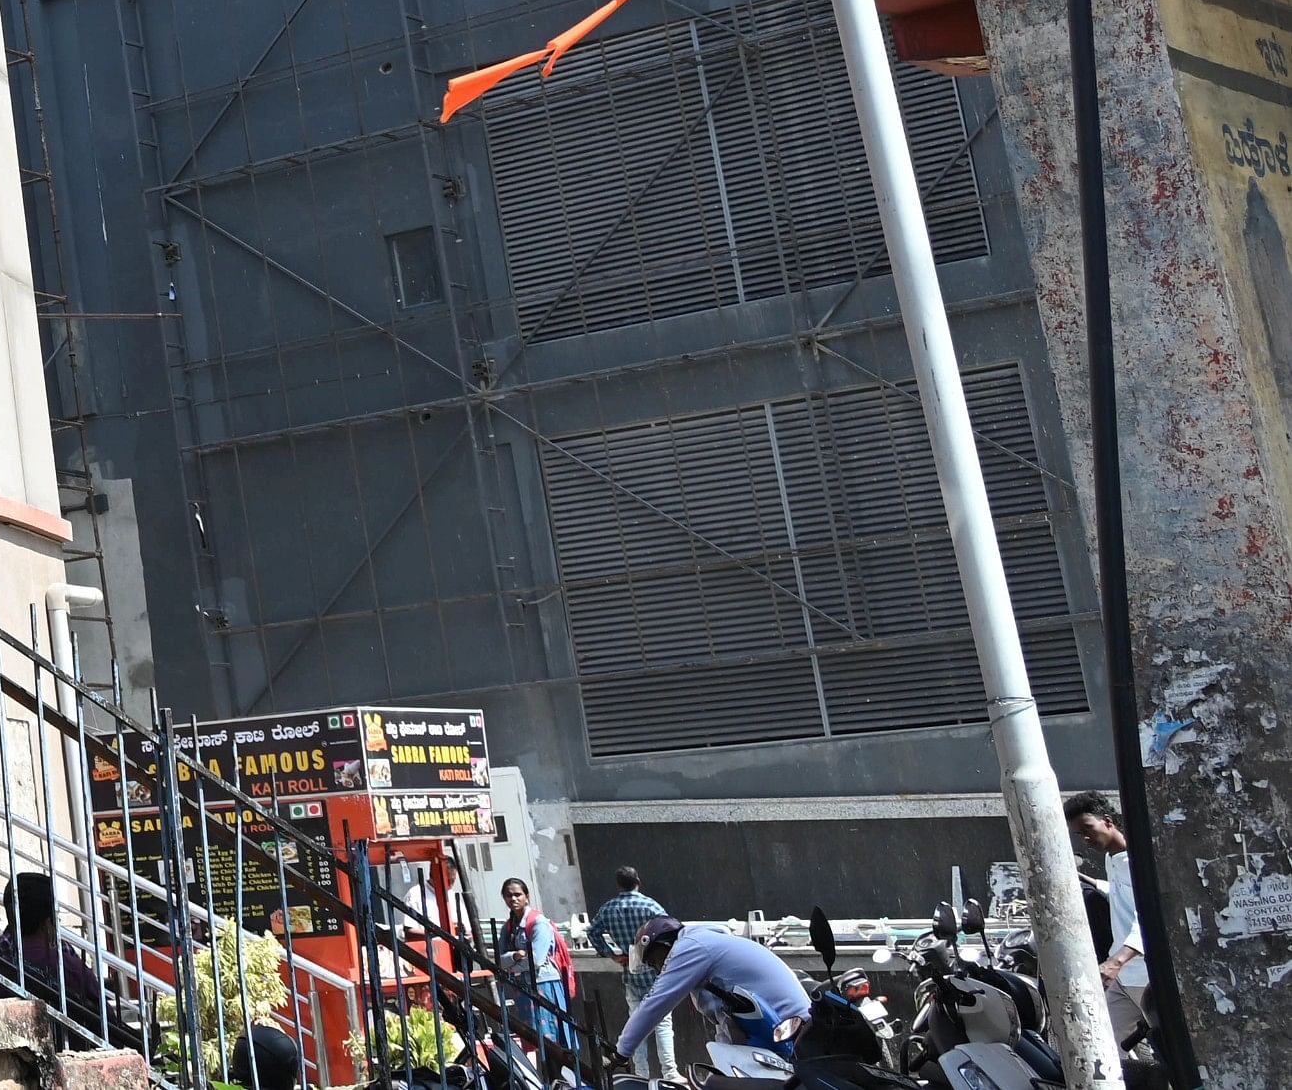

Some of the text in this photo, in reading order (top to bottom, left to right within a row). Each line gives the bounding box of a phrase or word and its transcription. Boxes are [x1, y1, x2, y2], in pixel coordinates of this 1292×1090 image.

[391, 745, 470, 764] SABRA FAMOUS
[439, 769, 472, 781] KATI ROLL
[287, 776, 328, 792] ROLL
[1233, 896, 1276, 908] WASHING
[1247, 906, 1290, 916] CONTACT
